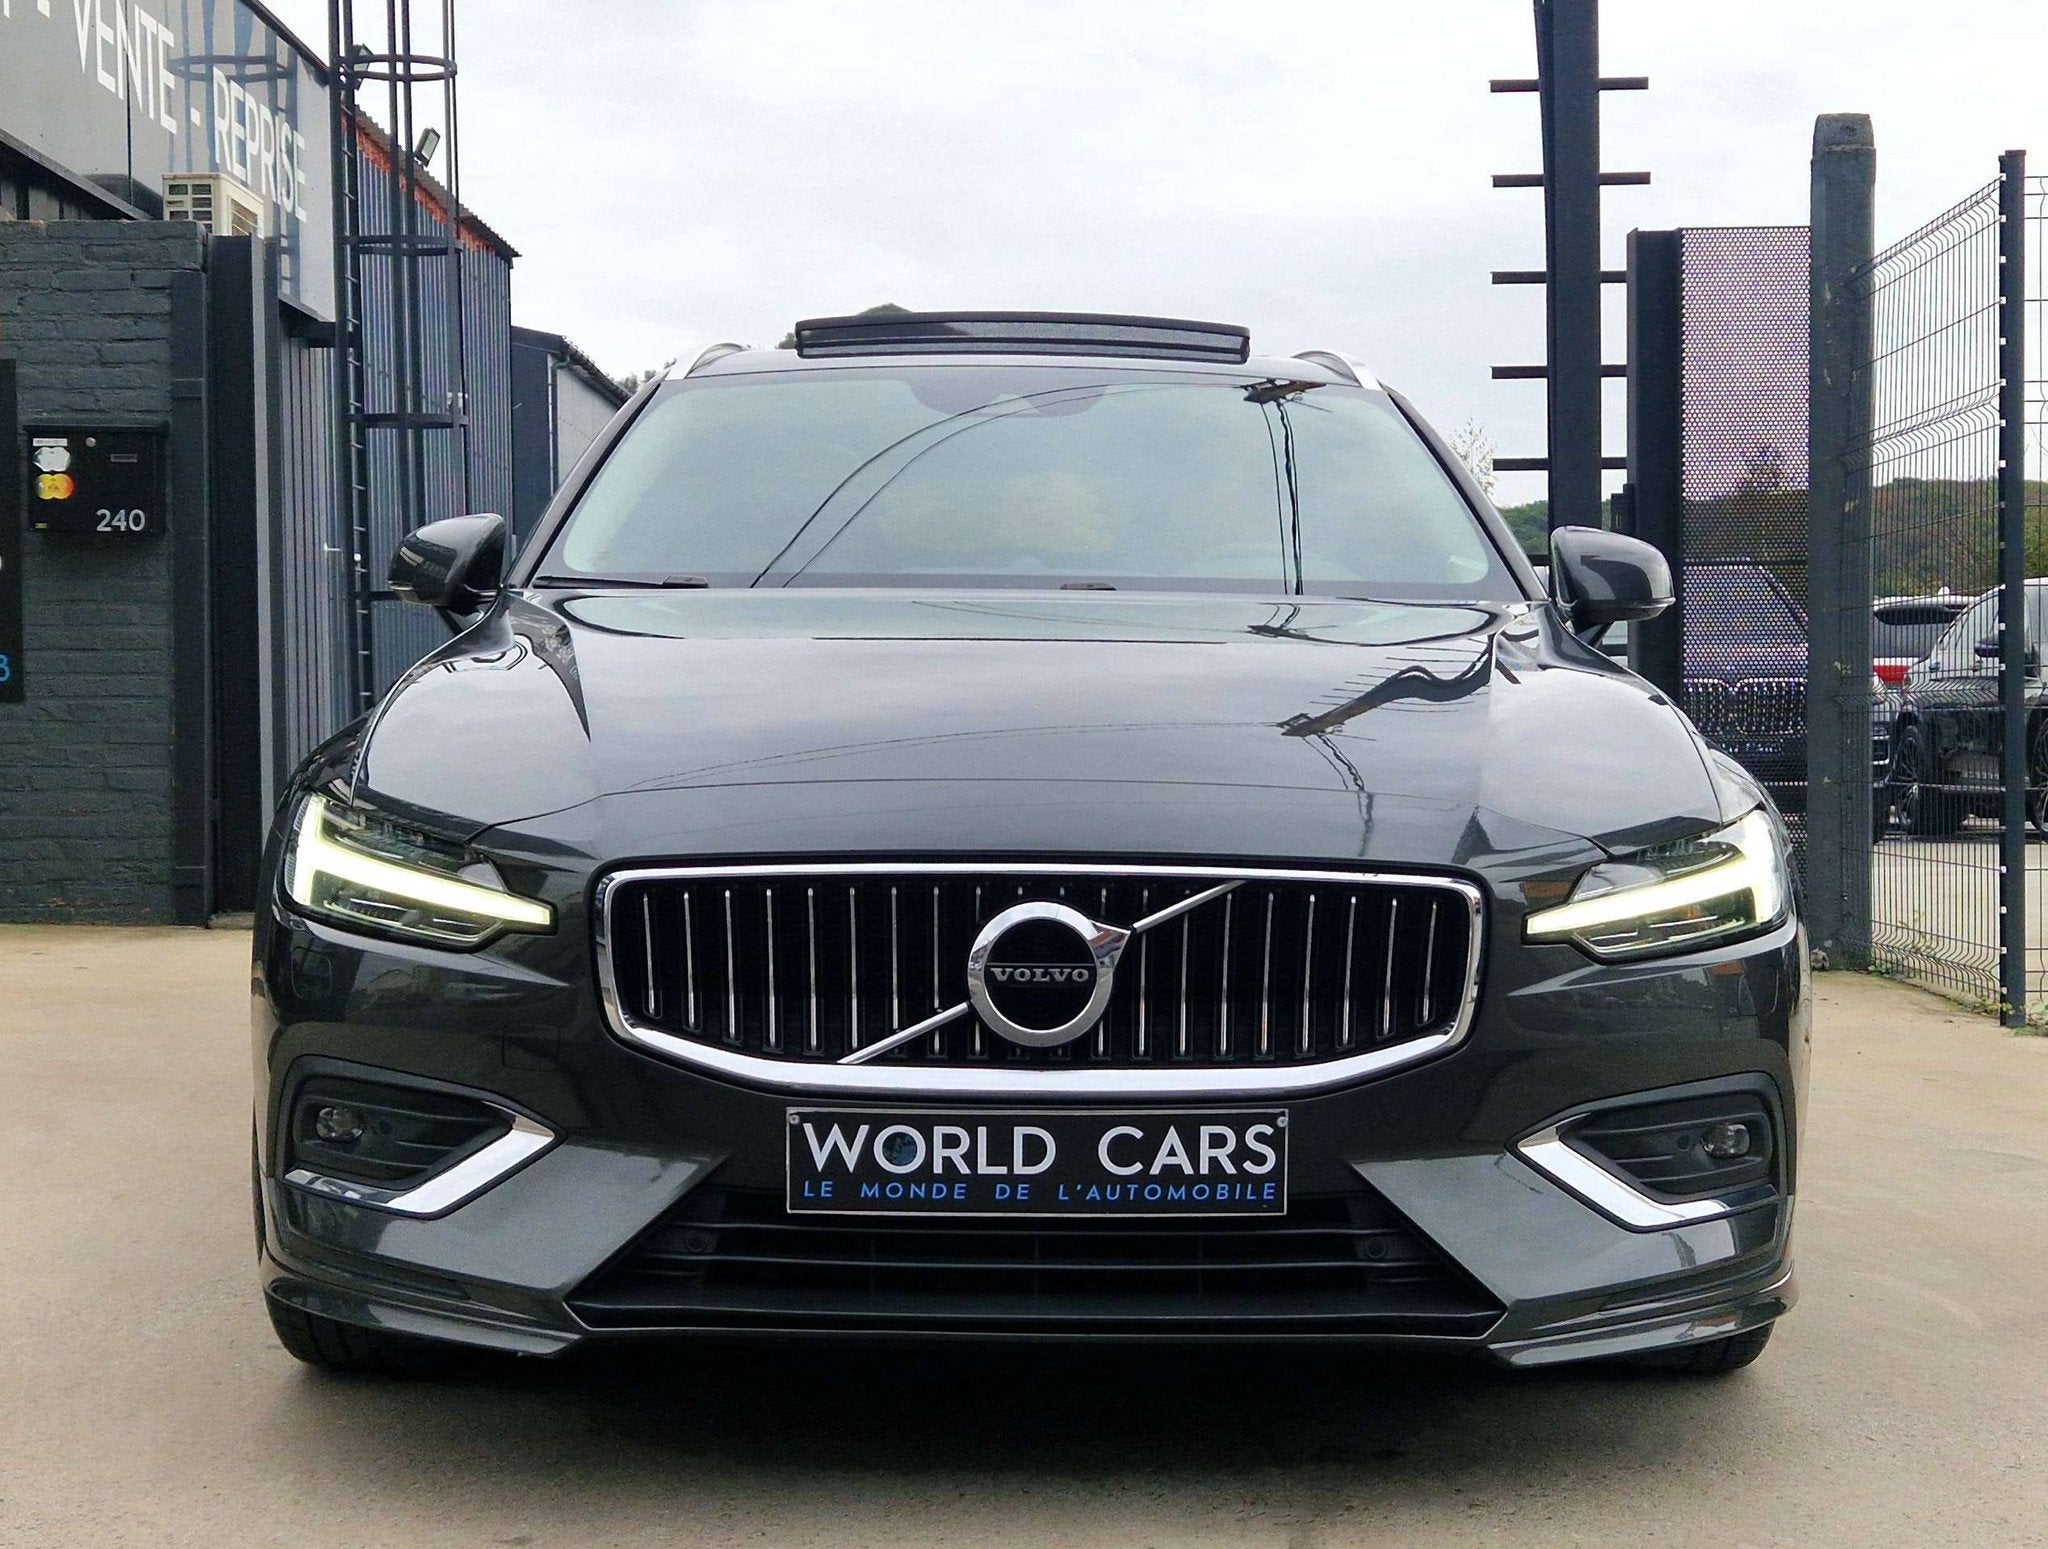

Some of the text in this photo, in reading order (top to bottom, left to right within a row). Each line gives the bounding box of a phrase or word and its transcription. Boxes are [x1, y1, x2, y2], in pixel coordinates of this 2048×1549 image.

[73, 0, 177, 135] VENTE
[212, 66, 307, 223] REPRISE
[96, 508, 146, 532] 240
[990, 967, 1090, 982] VOLVO
[803, 1123, 1276, 1175] WORLD CARS
[804, 1181, 1276, 1200] LE MONDE DE L'AUTOMOBILE
